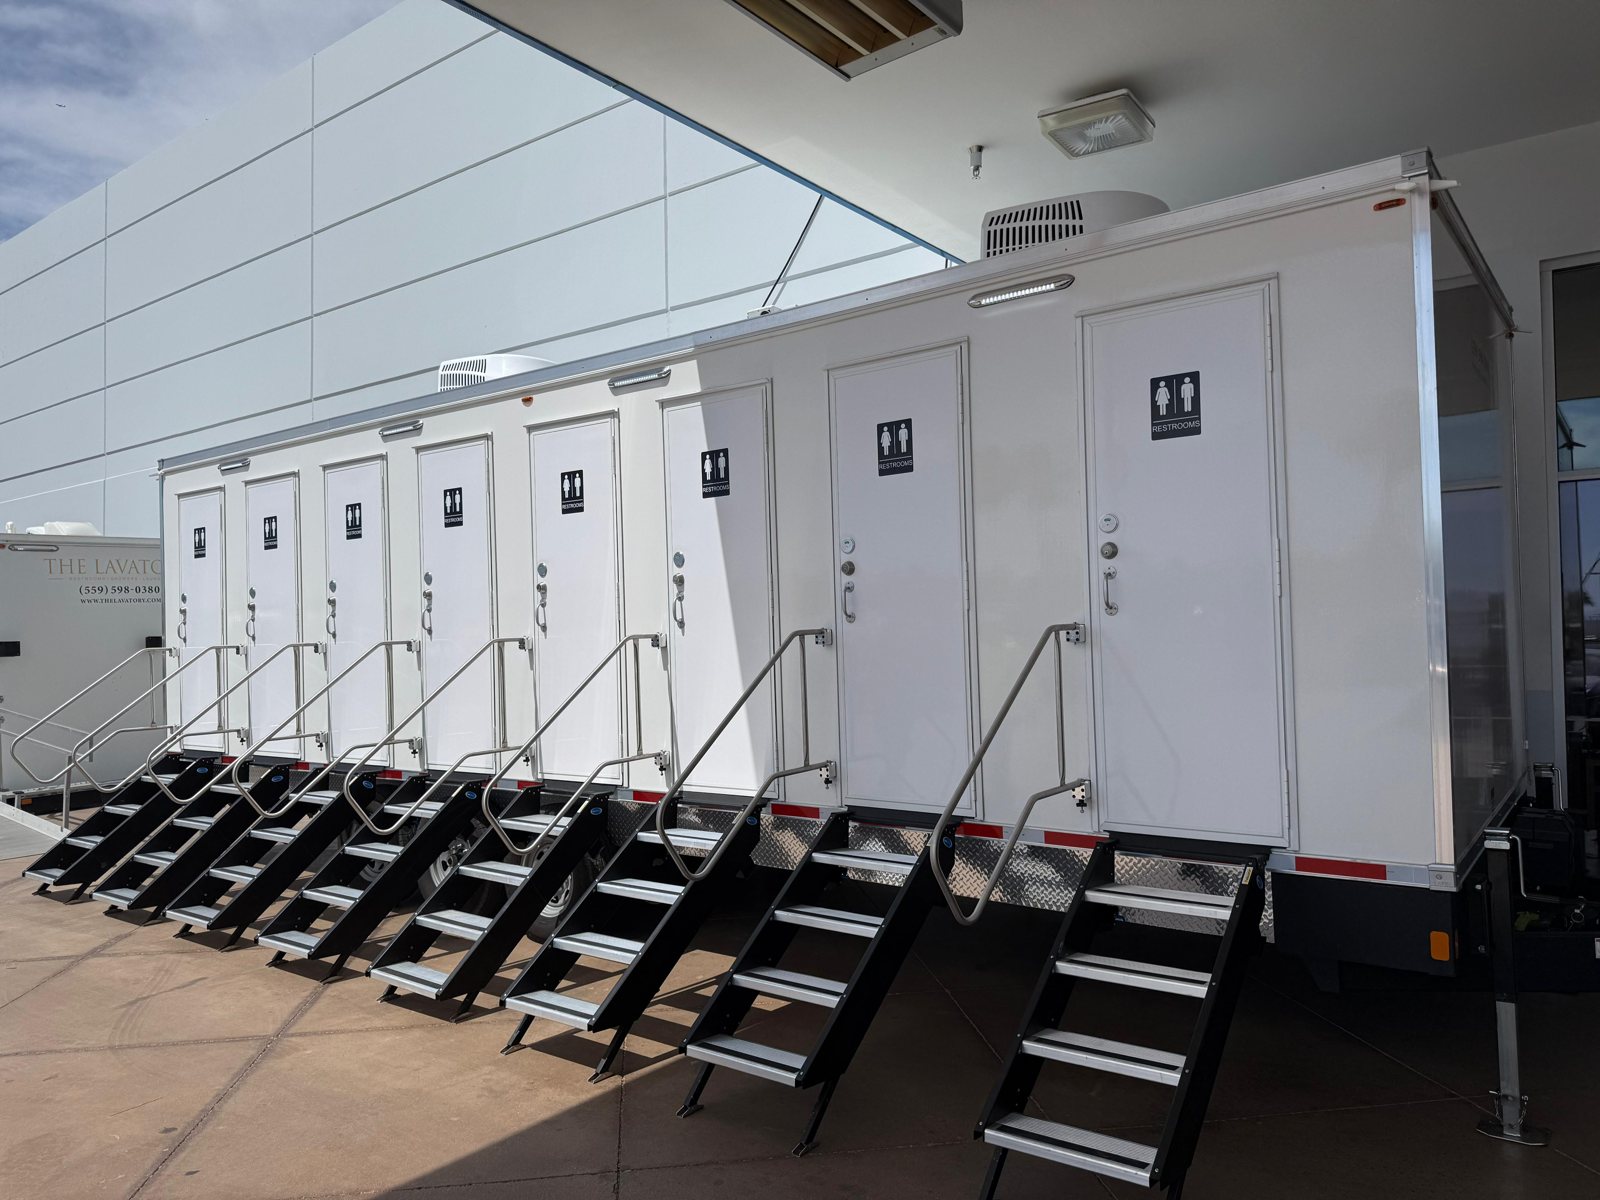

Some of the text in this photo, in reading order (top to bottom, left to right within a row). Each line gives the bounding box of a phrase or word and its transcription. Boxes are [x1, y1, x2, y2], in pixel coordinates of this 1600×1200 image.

[1152, 420, 1200, 432] RESTROOMS
[878, 459, 912, 470] RESTROOMS
[702, 484, 729, 493] RESTROOMS
[43, 558, 87, 575] THE
[79, 585, 161, 596] (559) 598-0380
